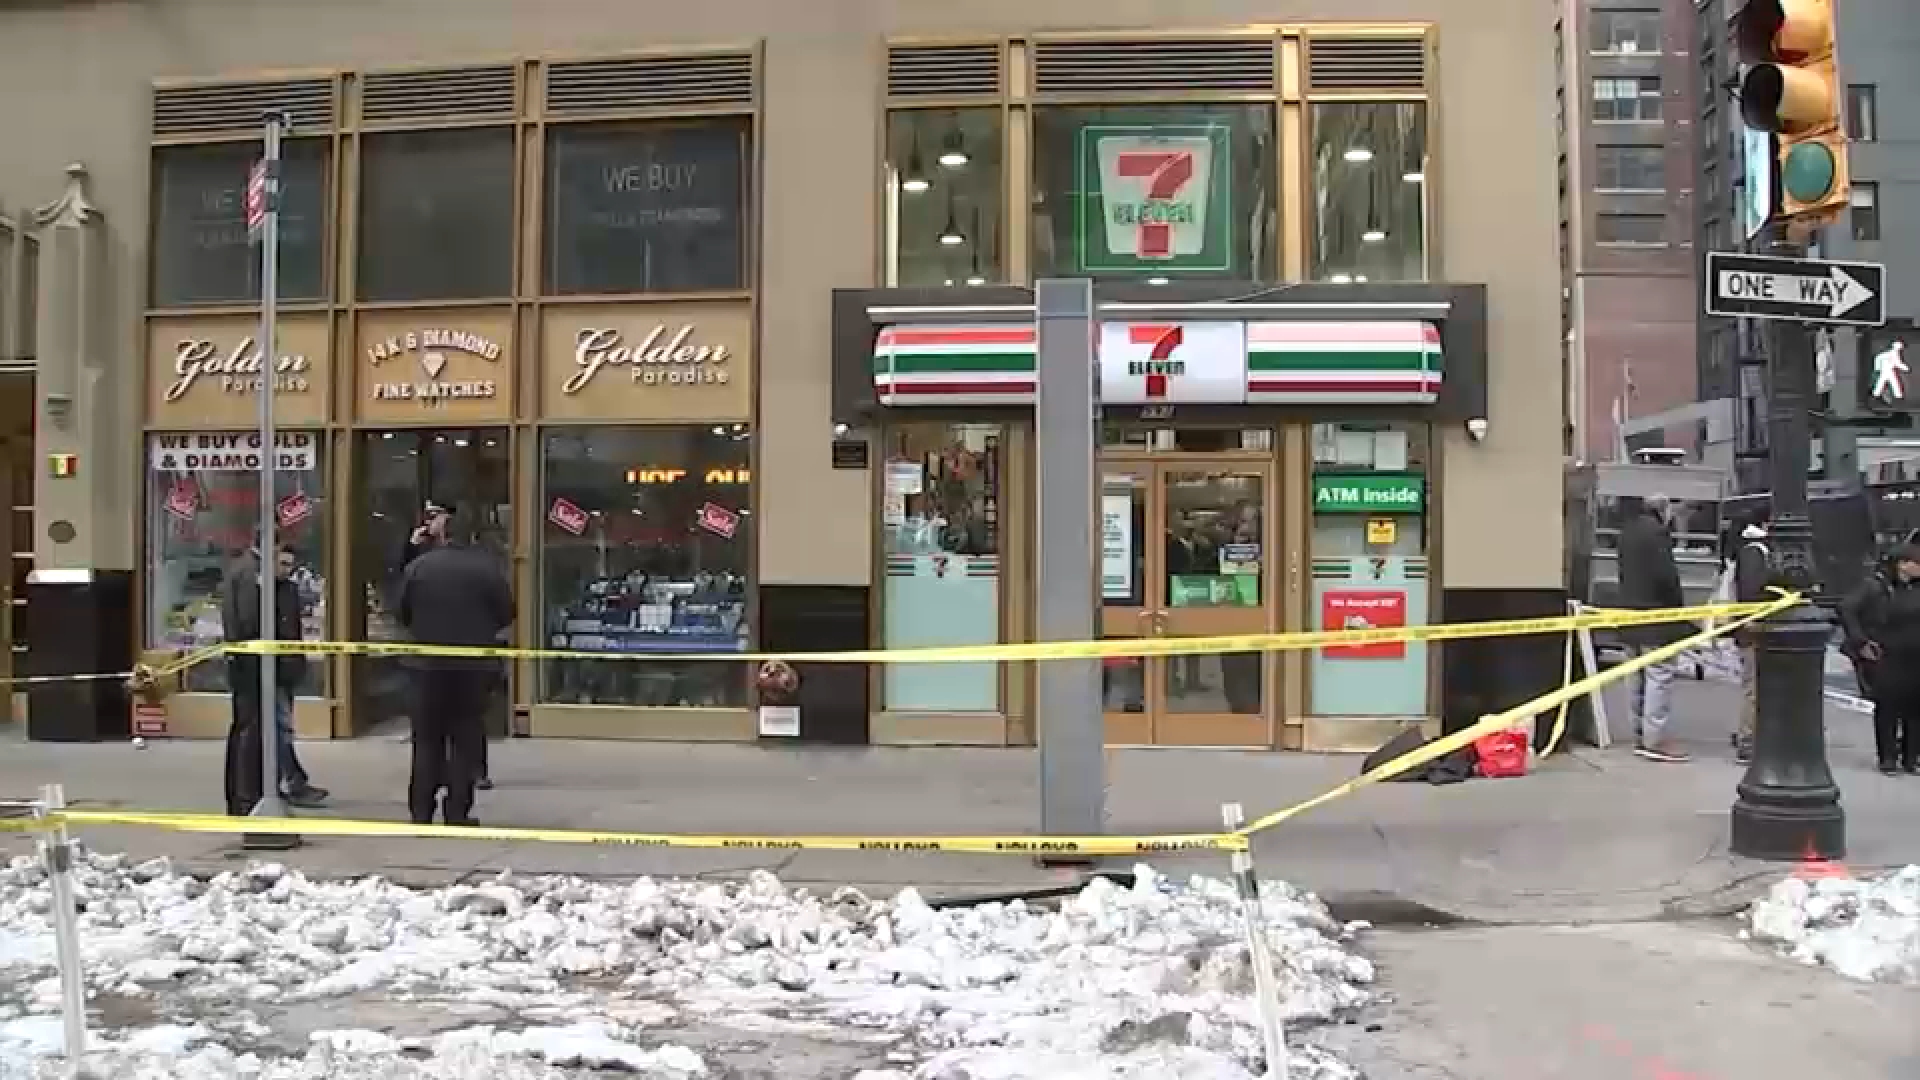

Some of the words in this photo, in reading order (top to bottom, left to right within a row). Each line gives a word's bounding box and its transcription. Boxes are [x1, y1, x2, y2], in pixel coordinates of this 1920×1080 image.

[648, 163, 697, 192] BUY
[1118, 153, 1193, 256] 7
[1728, 273, 1774, 297] ONE
[1800, 279, 1848, 303] WAY
[423, 329, 501, 361] DIAMOND
[562, 324, 731, 393] Golden
[164, 336, 311, 402] Goldn
[631, 366, 730, 384] Paradise
[1128, 325, 1184, 396] 7
[374, 383, 412, 399] FINE
[415, 381, 497, 399] WATCHES
[160, 434, 189, 449] WE
[198, 434, 238, 449] BUY
[248, 434, 309, 449] GLD
[161, 454, 176, 468] &
[186, 454, 307, 468] DIAMODS
[1317, 487, 1358, 502] ATM
[1364, 487, 1418, 502] Inside
